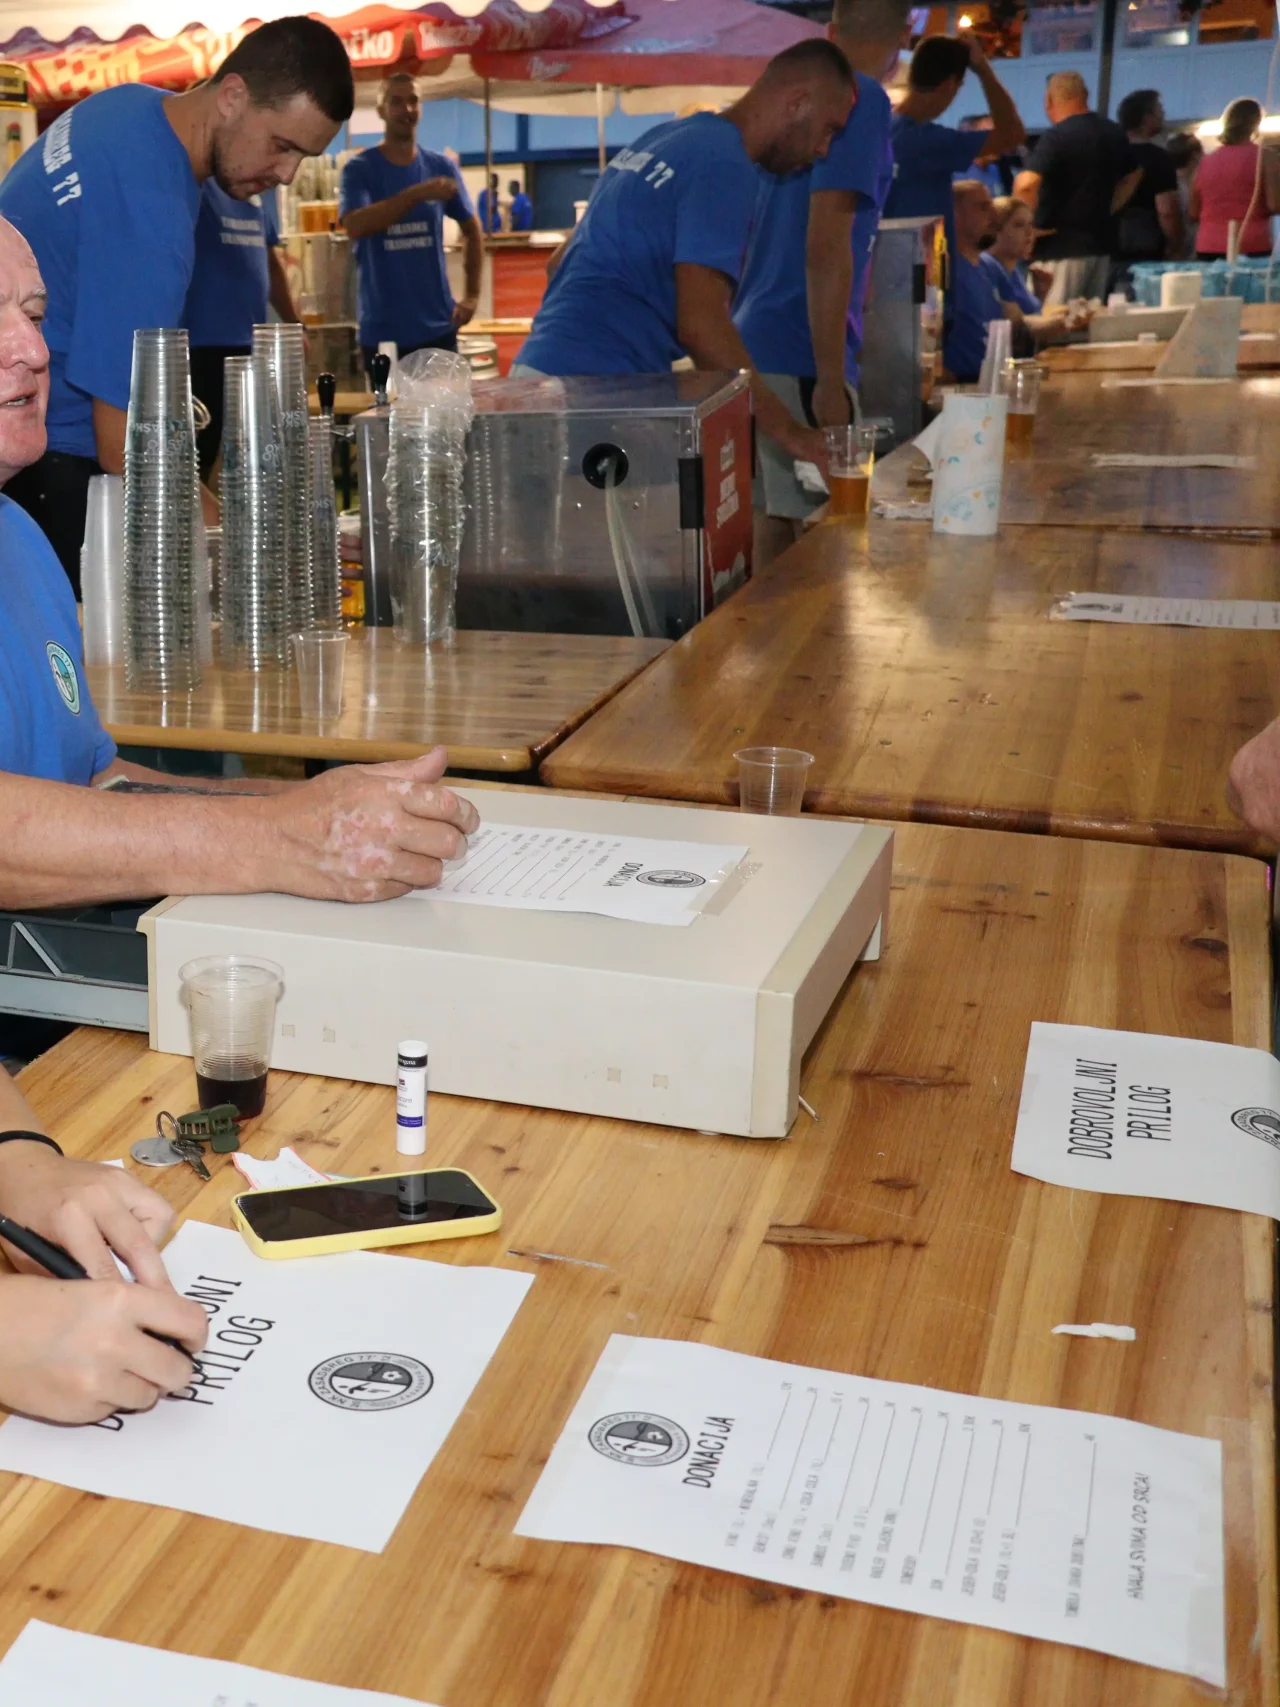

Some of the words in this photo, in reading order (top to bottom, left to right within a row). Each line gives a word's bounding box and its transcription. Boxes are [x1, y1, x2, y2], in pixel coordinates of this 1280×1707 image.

[1067, 1058, 1118, 1160] DOBROVOLJNI
[1127, 1085, 1172, 1142] PRILOG
[167, 1315, 277, 1405] PRILOG
[682, 1416, 735, 1489] DONACIJA
[1130, 1502, 1148, 1524] OD
[1126, 1562, 1145, 1601] HVALA
